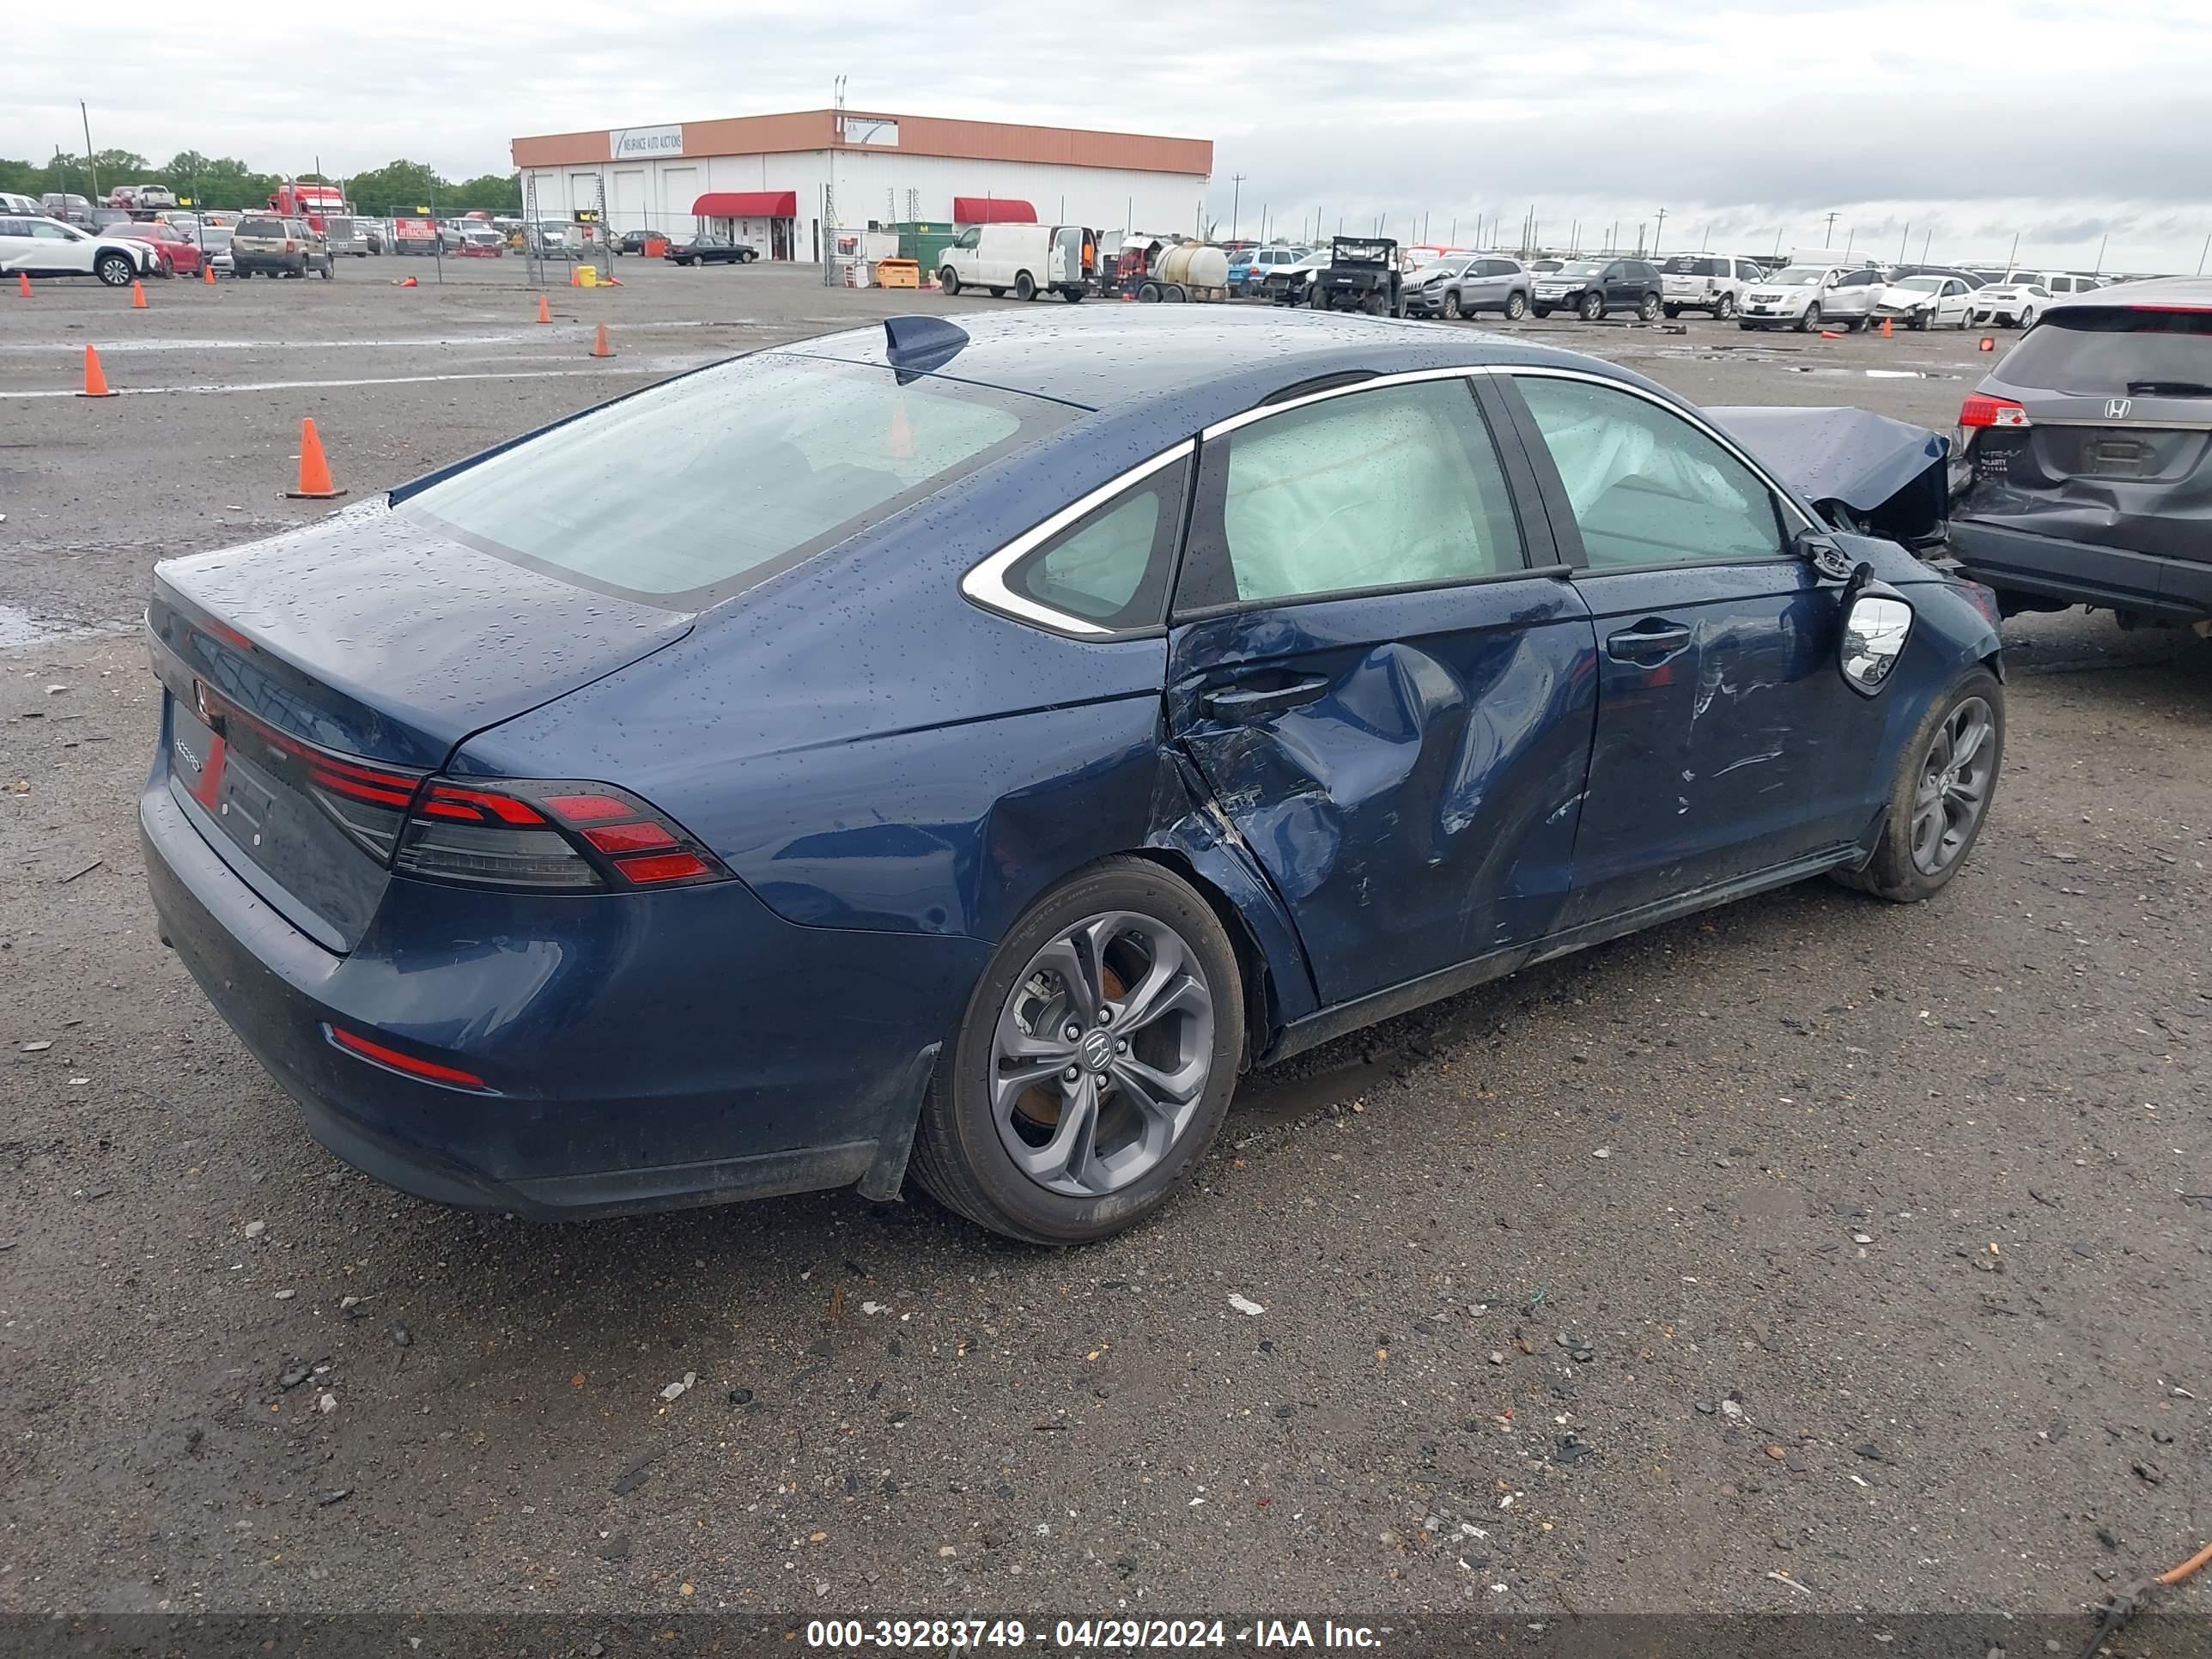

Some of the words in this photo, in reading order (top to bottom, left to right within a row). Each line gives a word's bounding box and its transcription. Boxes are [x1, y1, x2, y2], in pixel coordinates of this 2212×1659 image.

[647, 137, 659, 149] AUTO
[660, 134, 682, 149] AUCTIONS
[398, 228, 436, 238] ATTRACTIONS
